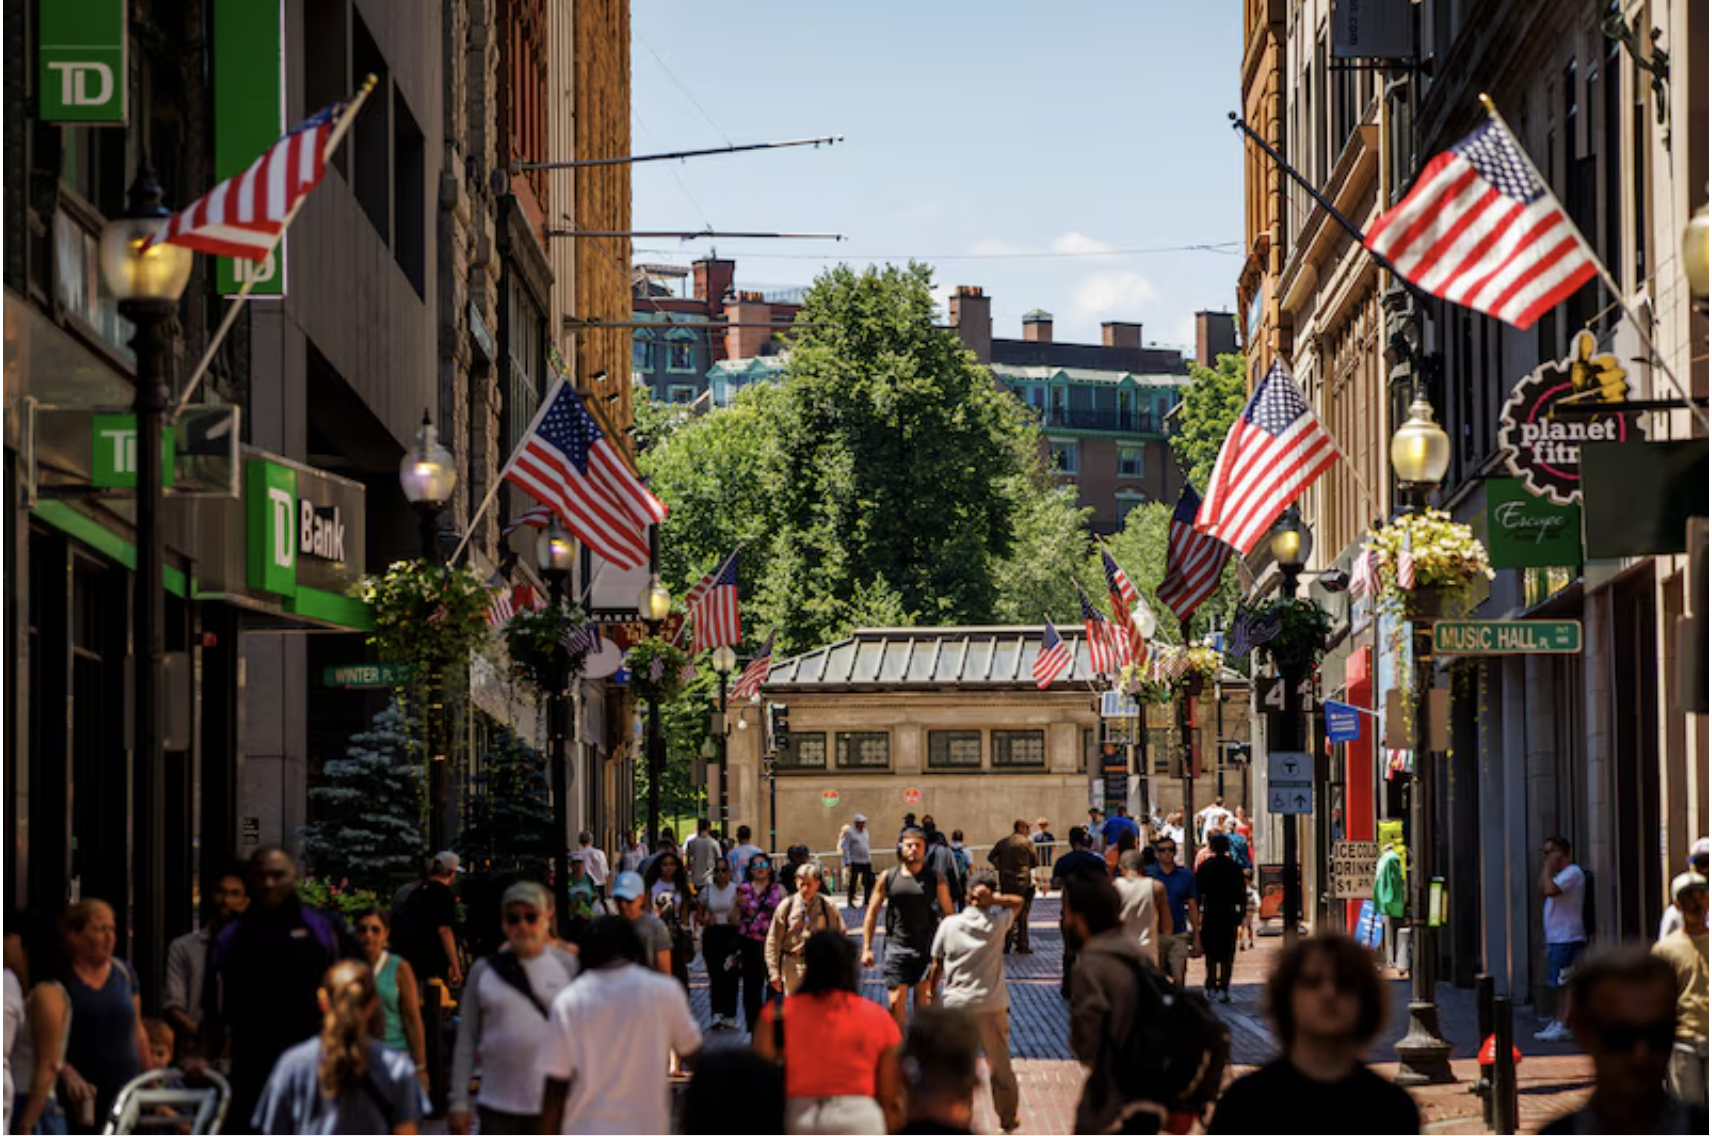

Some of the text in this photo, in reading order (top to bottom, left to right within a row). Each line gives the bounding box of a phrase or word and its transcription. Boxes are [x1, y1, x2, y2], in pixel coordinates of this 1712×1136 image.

[48, 62, 114, 105] TD
[1520, 417, 1616, 447] planet
[268, 487, 345, 567] TD Bank
[1494, 501, 1564, 544] Escape
[1441, 626, 1492, 649] MUSIC
[1498, 627, 1537, 648] HALL
[335, 667, 379, 682] WINTER
[1334, 844, 1356, 858] ICE
